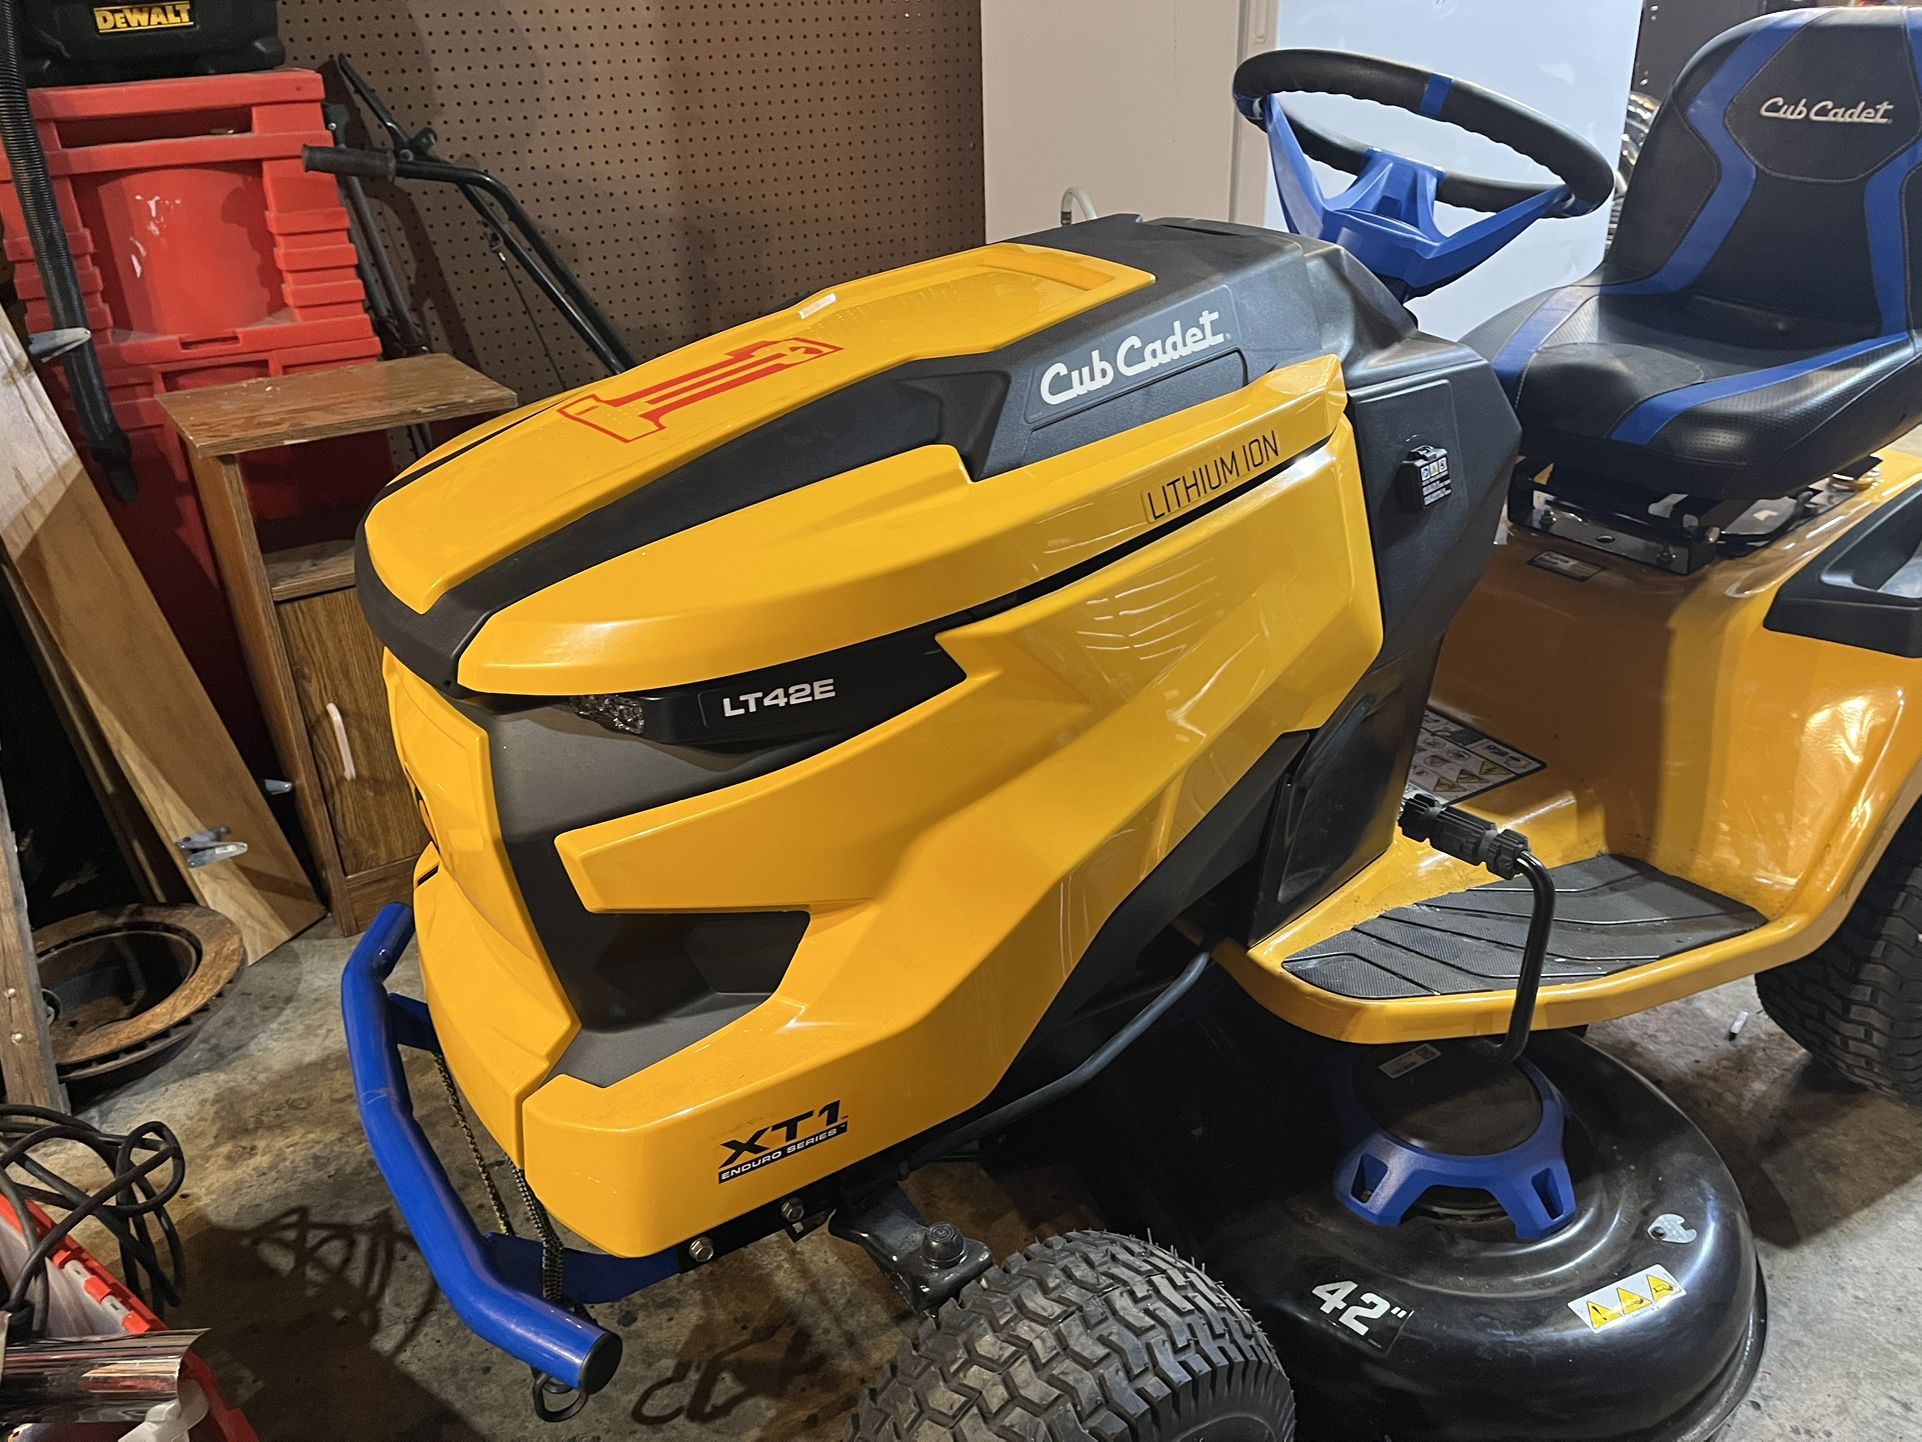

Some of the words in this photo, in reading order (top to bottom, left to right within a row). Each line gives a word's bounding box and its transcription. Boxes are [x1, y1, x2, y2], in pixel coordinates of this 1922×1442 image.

[95, 3, 190, 29] DEWALT
[1760, 96, 1808, 120] Cub
[1809, 100, 1894, 124] Cadet
[1040, 350, 1114, 405] Cub
[1116, 310, 1225, 376] Cadet
[1147, 450, 1240, 520] LITHIUM
[1242, 430, 1279, 472] ION
[722, 678, 836, 717] LT42E
[718, 1100, 841, 1169] XT1
[721, 1150, 782, 1180] ENDURO
[786, 1128, 838, 1154] SERIES
[1311, 1280, 1408, 1336] 42"
